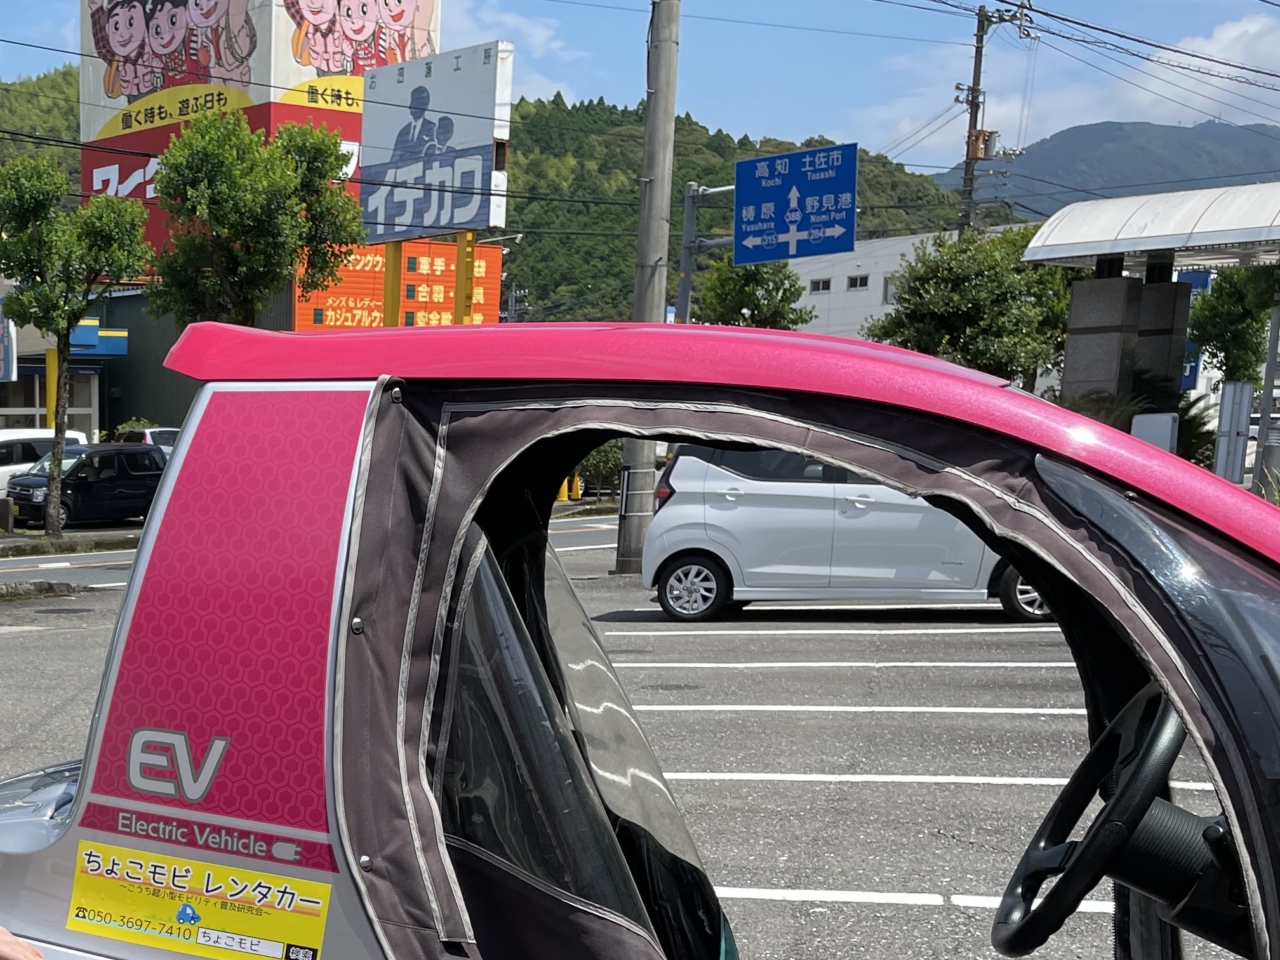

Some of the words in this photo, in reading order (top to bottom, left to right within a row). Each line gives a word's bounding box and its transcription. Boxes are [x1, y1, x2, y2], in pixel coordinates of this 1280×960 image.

[755, 158, 790, 178] 高知
[801, 150, 842, 172] 土佐市
[761, 177, 782, 188] Kochi
[807, 168, 836, 181] Tosashi
[368, 155, 483, 235] イチカワ
[805, 192, 852, 213] 野見港
[741, 221, 775, 233] Yusuhara
[810, 213, 829, 223] Nomi
[830, 211, 846, 221] Port
[326, 297, 347, 307] メンズ
[126, 727, 231, 803] EV
[117, 811, 188, 843] Electric
[193, 824, 267, 857] Vehicle
[83, 850, 191, 891] ちょこモビ
[204, 872, 322, 910] レンタカー
[87, 909, 192, 941] 050-3697-7410
[200, 931, 261, 953] ちょこモビ
